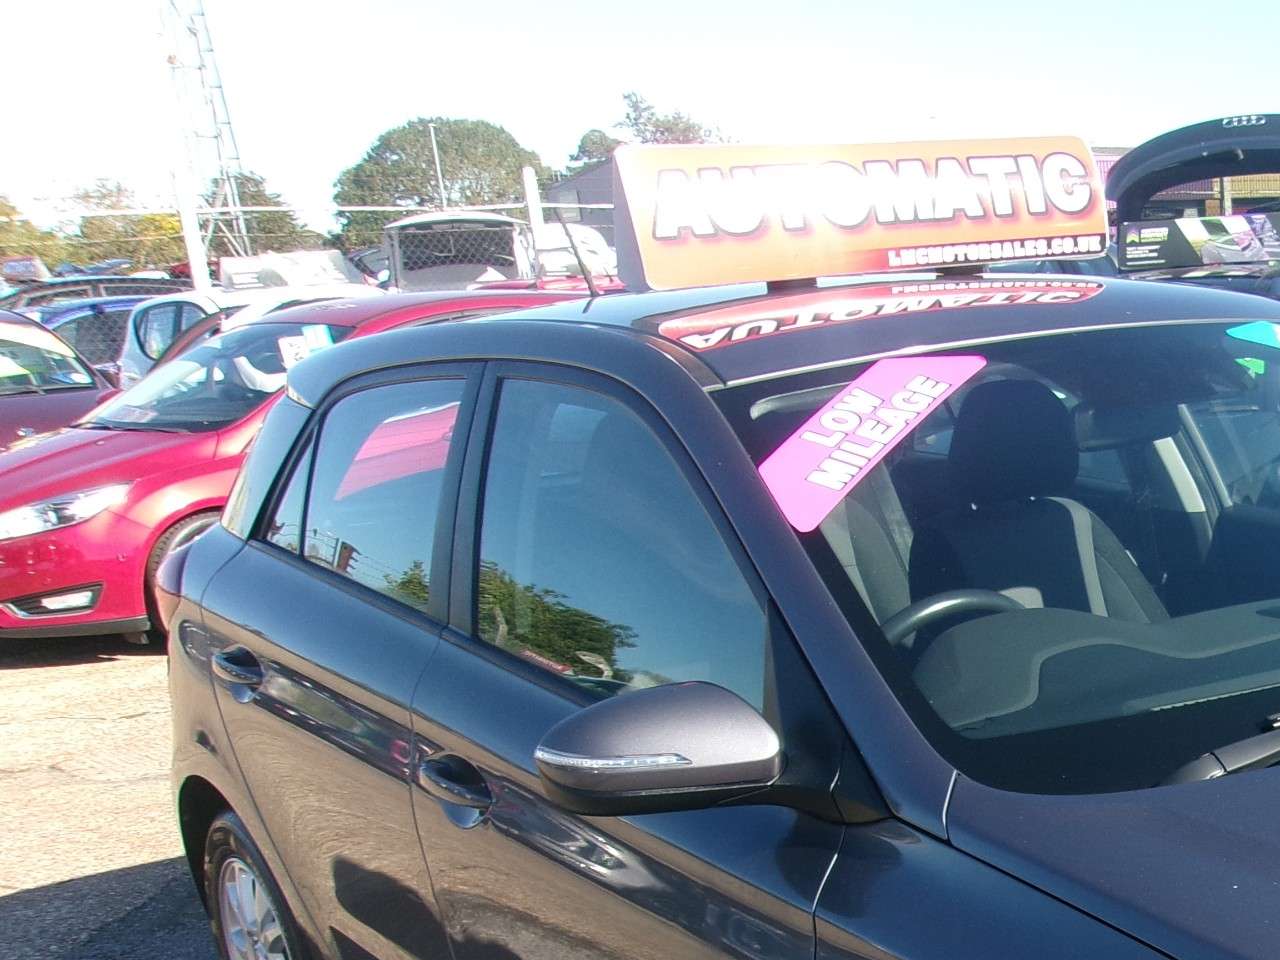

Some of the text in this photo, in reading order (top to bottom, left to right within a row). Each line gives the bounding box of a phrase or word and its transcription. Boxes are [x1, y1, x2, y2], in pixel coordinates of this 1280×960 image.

[652, 151, 1094, 241] AUTOMATIC
[799, 386, 886, 449] LOW
[804, 374, 953, 492] MILEAGE
